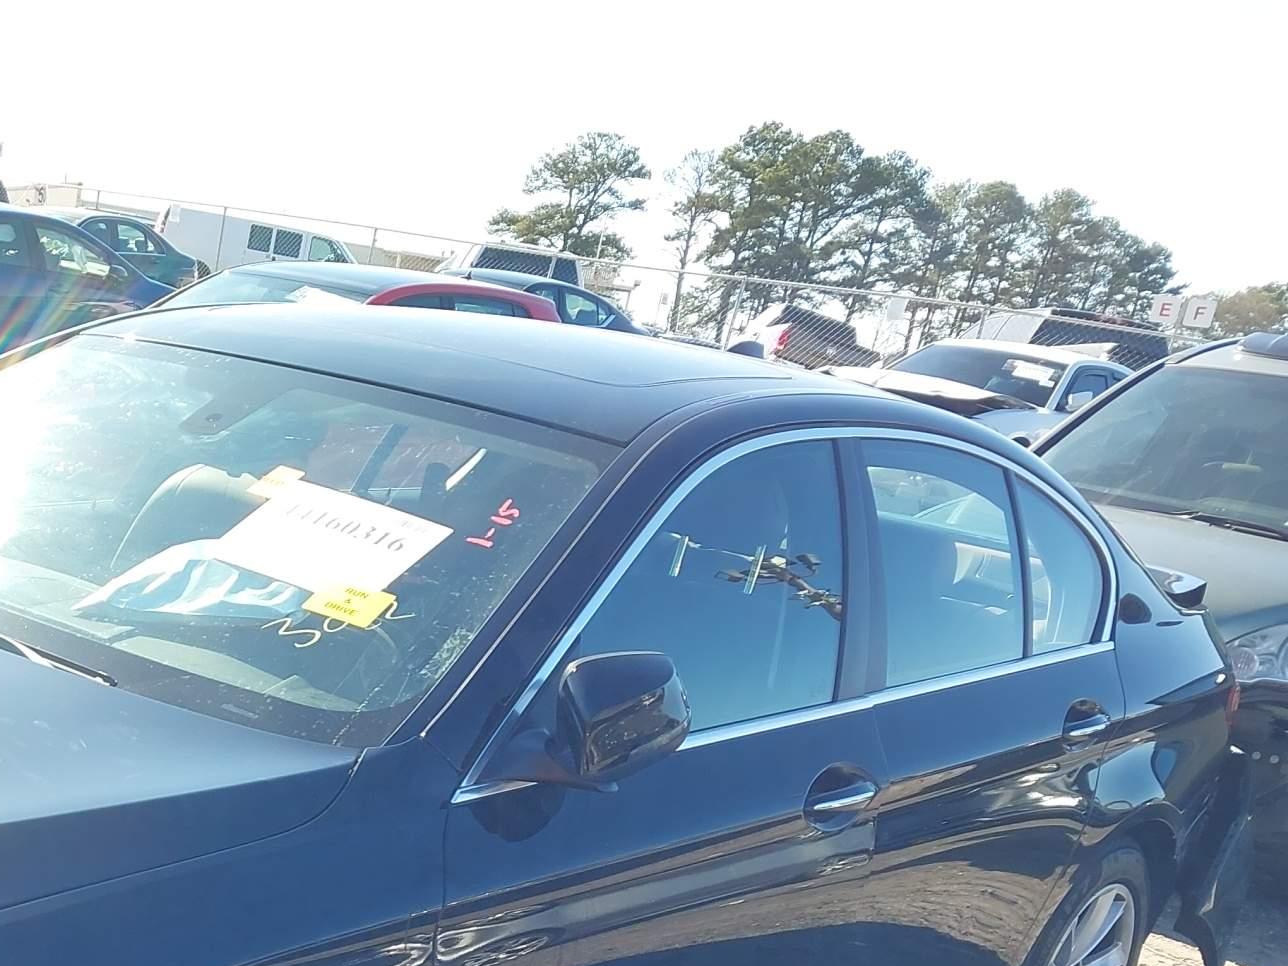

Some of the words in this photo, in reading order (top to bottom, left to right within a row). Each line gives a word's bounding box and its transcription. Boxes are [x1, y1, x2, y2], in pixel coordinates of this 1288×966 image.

[1159, 302, 1173, 317] E
[1193, 306, 1208, 321] F
[344, 587, 370, 600] RUN
[324, 601, 359, 616] DRIVE
